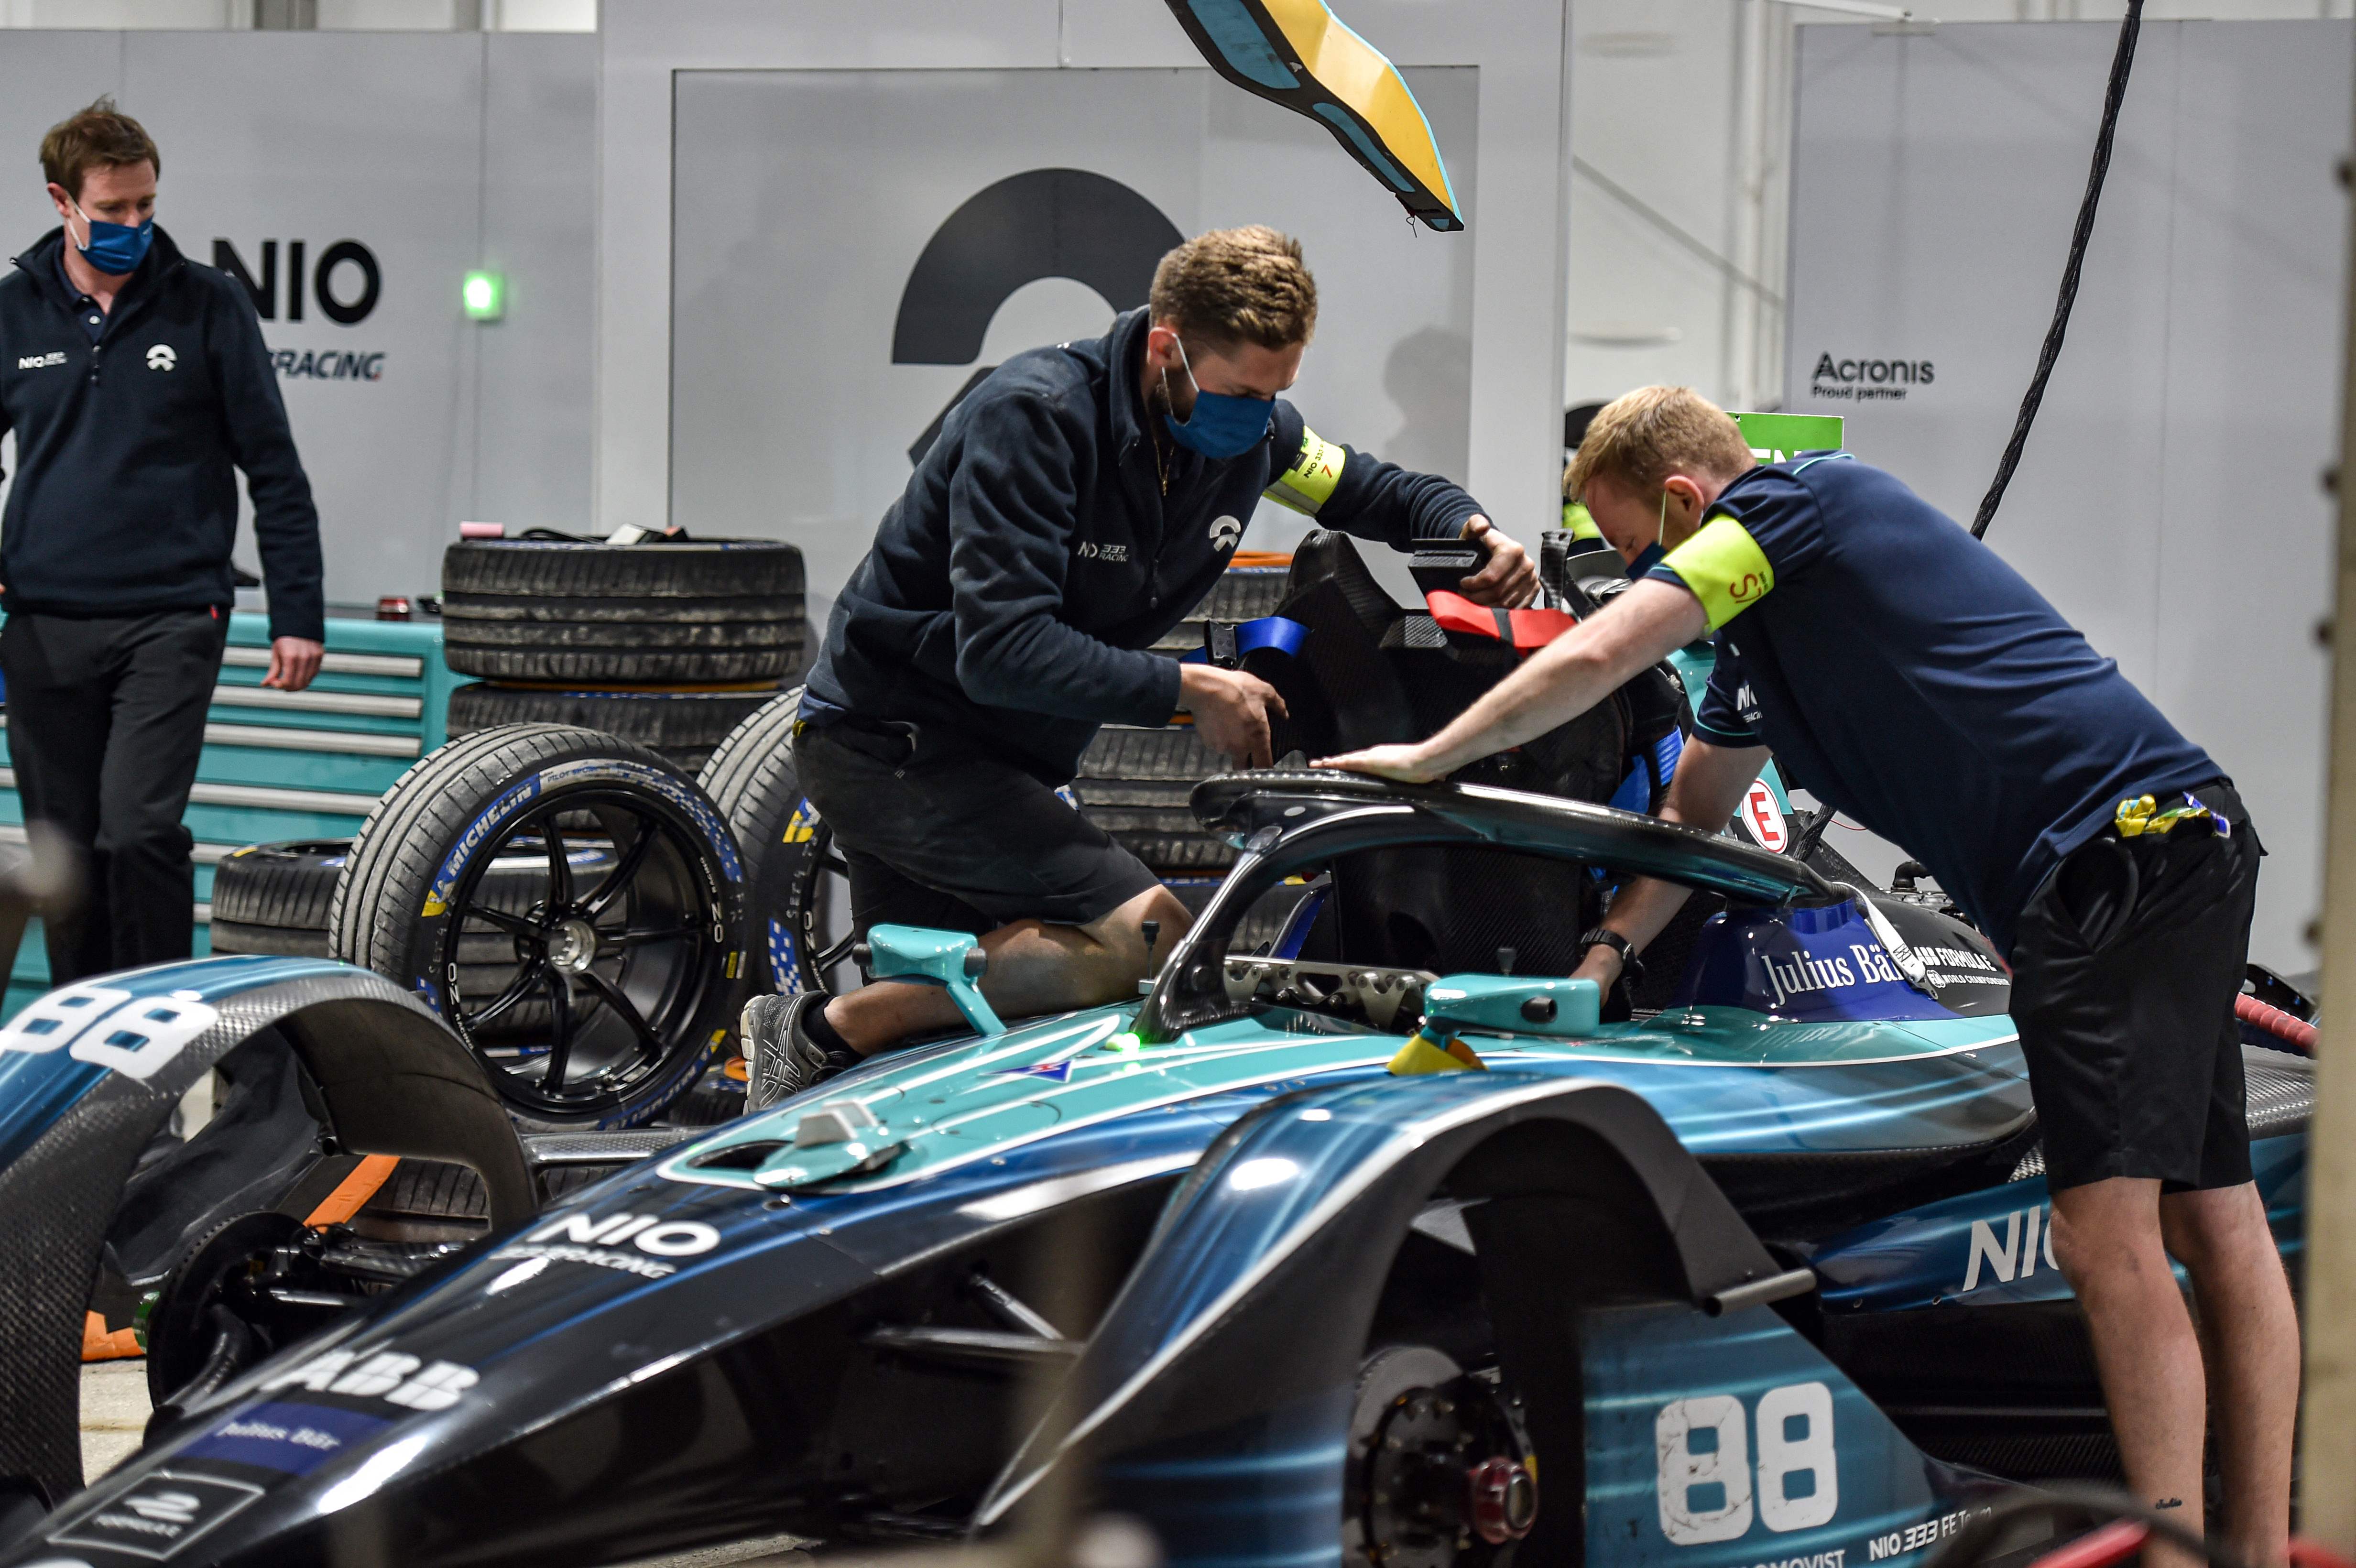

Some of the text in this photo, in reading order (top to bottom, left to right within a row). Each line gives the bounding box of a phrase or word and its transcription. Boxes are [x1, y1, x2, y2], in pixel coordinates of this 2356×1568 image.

[213, 240, 382, 326] NIO
[19, 356, 45, 370] NIO
[1812, 352, 1934, 384] Acronis
[1810, 385, 1907, 403] Proud partner
[1303, 462, 1317, 478] NIO
[1099, 552, 1129, 562] RACING
[447, 783, 532, 877] MICHELIN
[1749, 792, 1780, 841] E
[1761, 950, 1855, 1006] Julius
[1935, 947, 1990, 971] FORMULA
[1980, 955, 1997, 971] E
[1941, 974, 1966, 983] WORLD
[0, 986, 218, 1079] 88
[527, 1213, 720, 1256] NIO
[259, 1350, 480, 1411] ABB
[1656, 1382, 1838, 1545] 88
[1869, 1533, 1901, 1561] NIO
[1903, 1520, 1939, 1552] 333
[1942, 1514, 1957, 1537] FE
